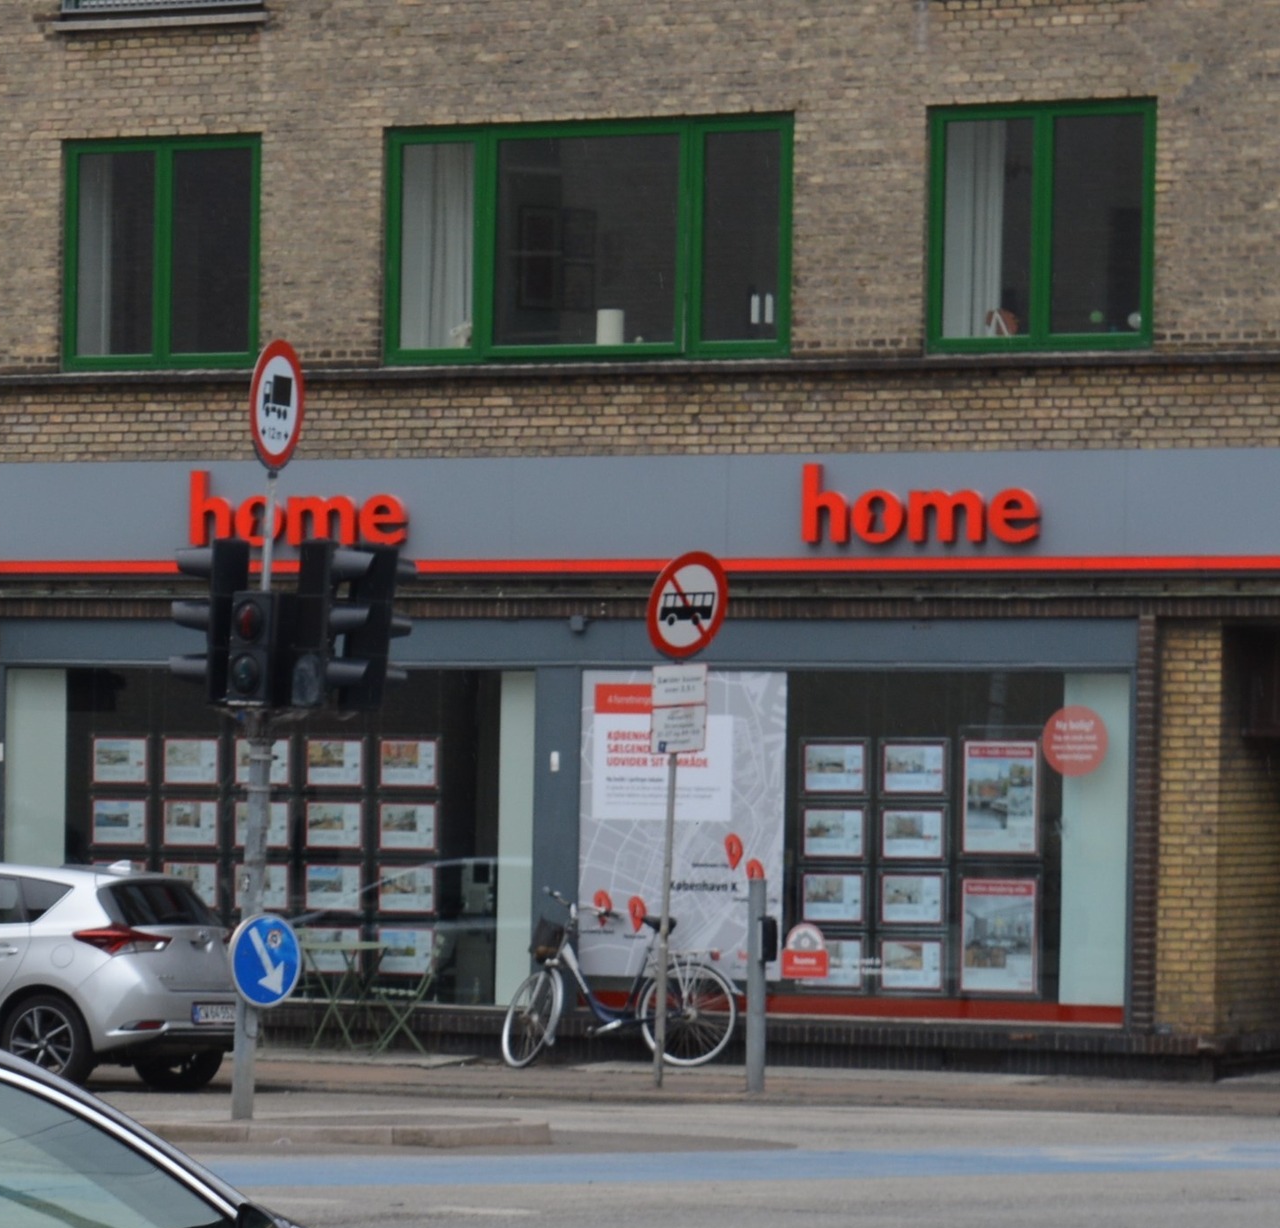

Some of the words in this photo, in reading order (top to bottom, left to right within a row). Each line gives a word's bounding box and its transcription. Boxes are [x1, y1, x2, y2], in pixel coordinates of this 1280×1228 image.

[189, 470, 408, 547] home
[801, 463, 1040, 545] home
[606, 757, 648, 767] UDVIDER
